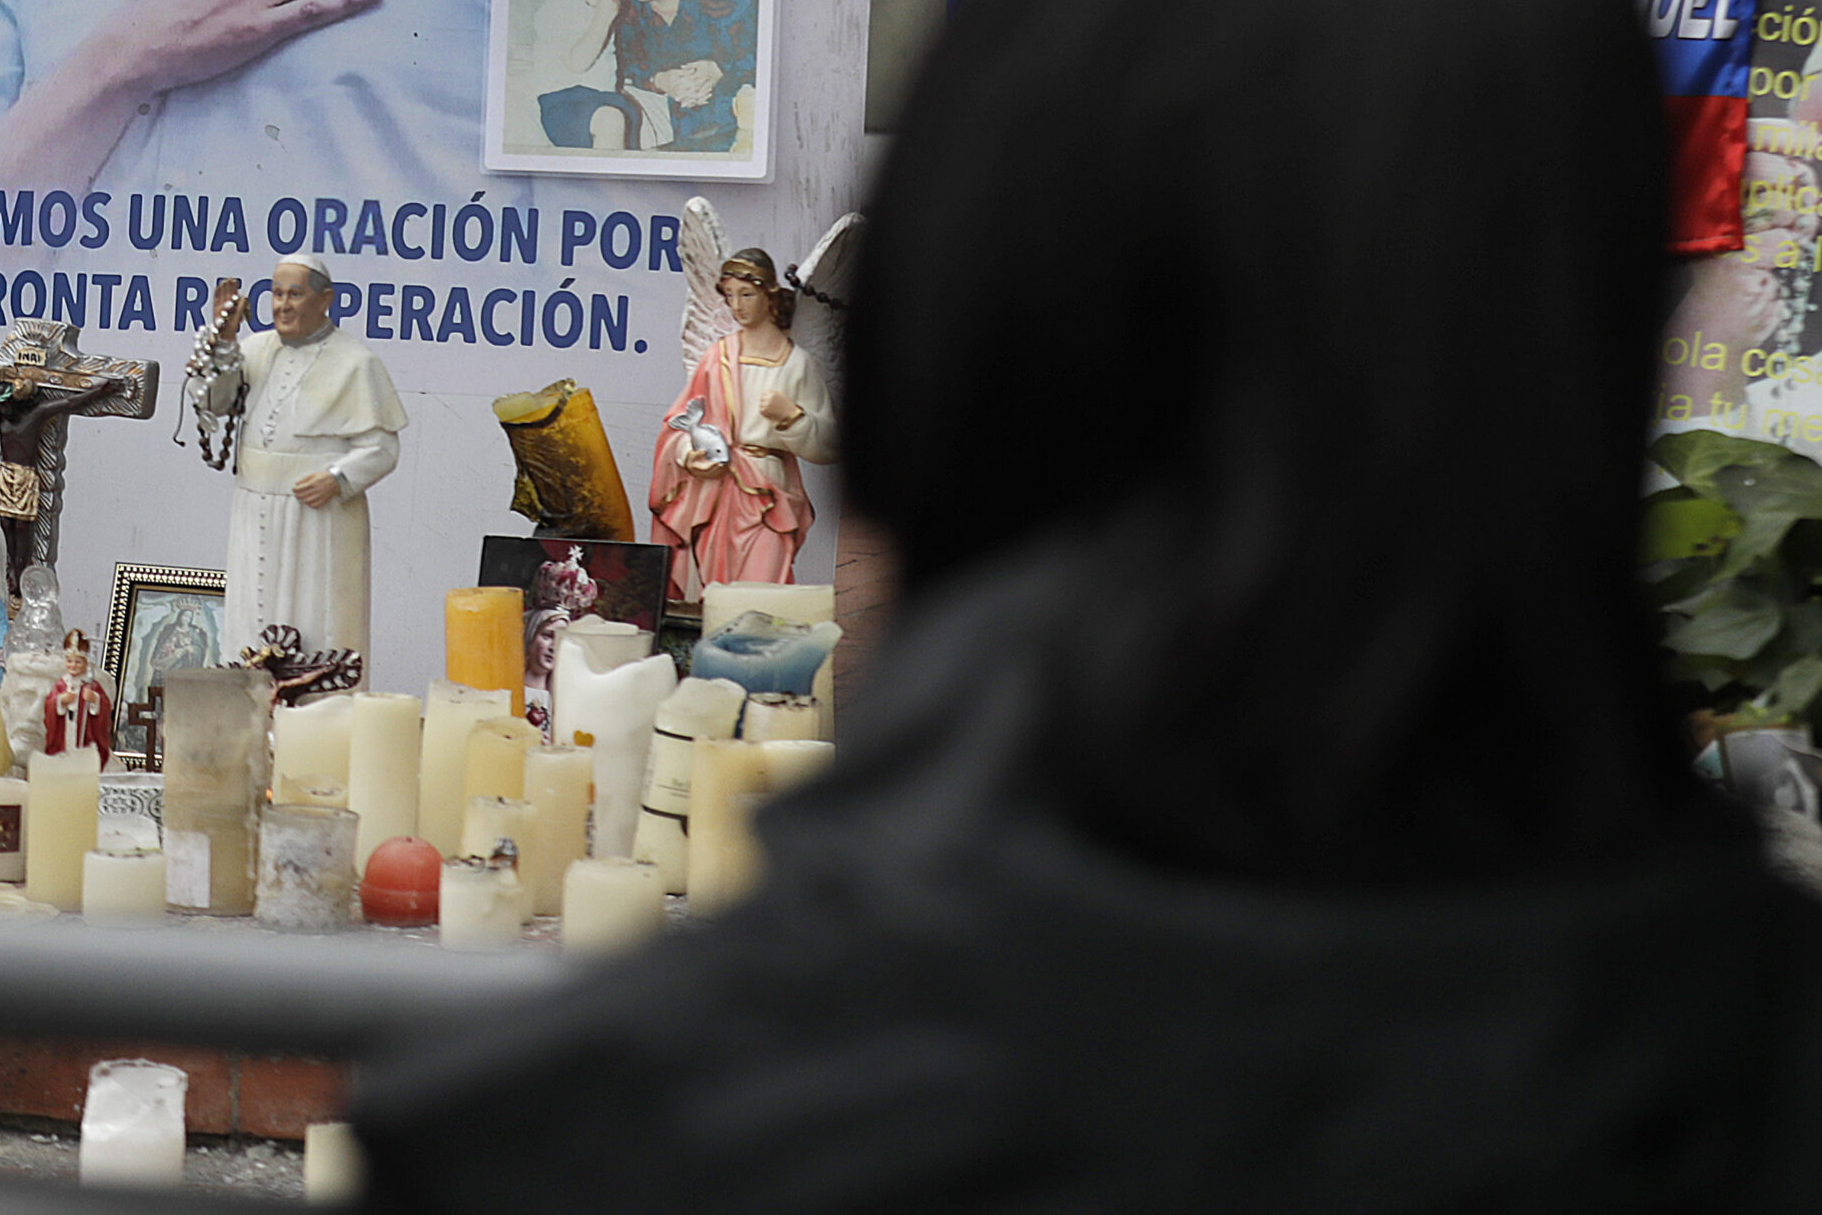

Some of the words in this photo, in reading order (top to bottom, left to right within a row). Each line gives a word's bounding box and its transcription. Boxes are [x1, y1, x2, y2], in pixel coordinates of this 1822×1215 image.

[127, 193, 250, 253] UNA
[266, 190, 540, 265] ORACIÓN
[560, 209, 685, 273] POR
[173, 275, 649, 354] RCPERACIÓN.
[18, 351, 42, 364] INRI
